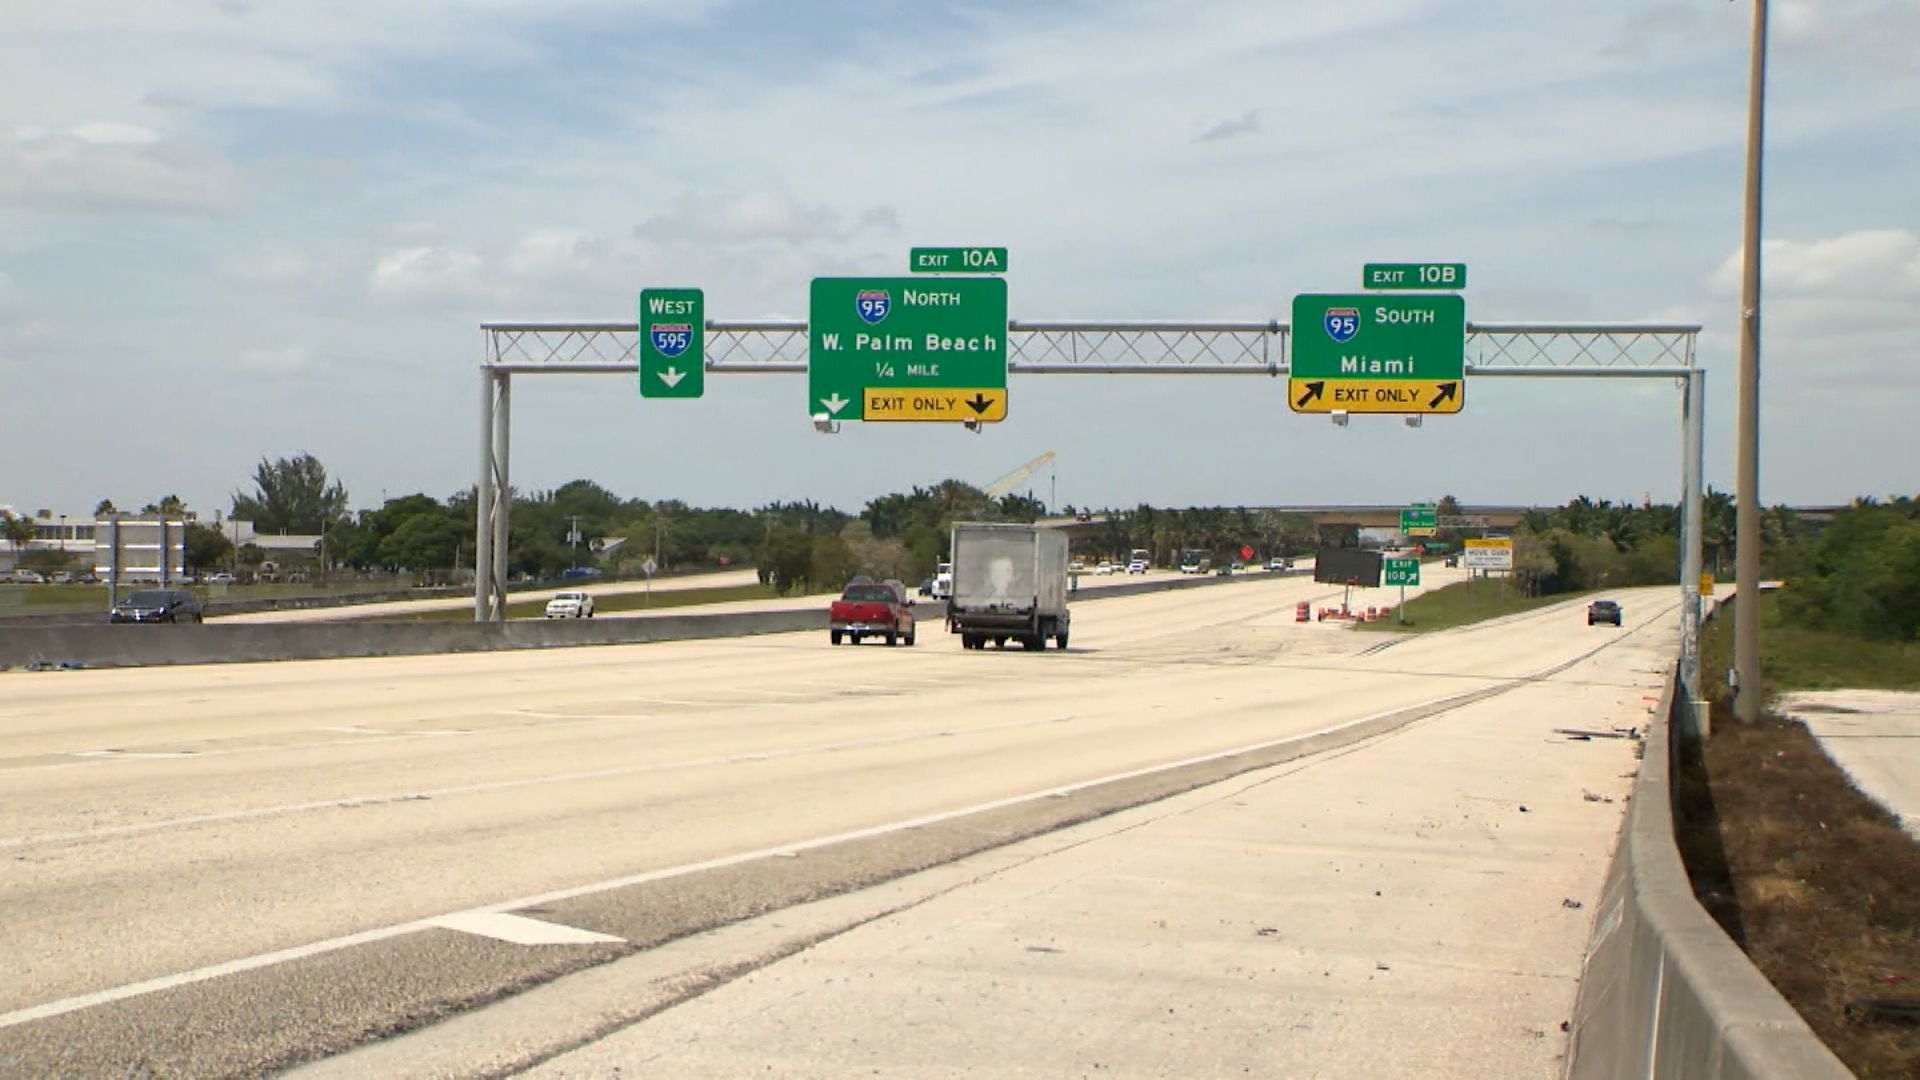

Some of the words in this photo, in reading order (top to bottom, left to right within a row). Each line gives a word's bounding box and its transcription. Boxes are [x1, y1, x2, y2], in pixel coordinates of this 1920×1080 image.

[919, 255, 949, 266] EXIT
[962, 250, 998, 266] 10A
[1373, 271, 1405, 282] EXIT
[1419, 266, 1456, 282] 10B
[648, 296, 695, 315] WEST
[861, 301, 885, 317] 95
[903, 288, 961, 306] NORTH
[1330, 318, 1355, 334] 95
[1375, 307, 1435, 323] SOUTH
[658, 333, 686, 349] 595
[822, 333, 843, 350] W.
[856, 333, 912, 351] Palm
[926, 333, 997, 351] Beach
[907, 364, 939, 376] MILE
[1341, 355, 1414, 373] Miami
[1335, 389, 1369, 402] EXIT
[1375, 389, 1420, 402] ONLY
[871, 397, 905, 411] EXIT
[913, 397, 957, 411] ONLY
